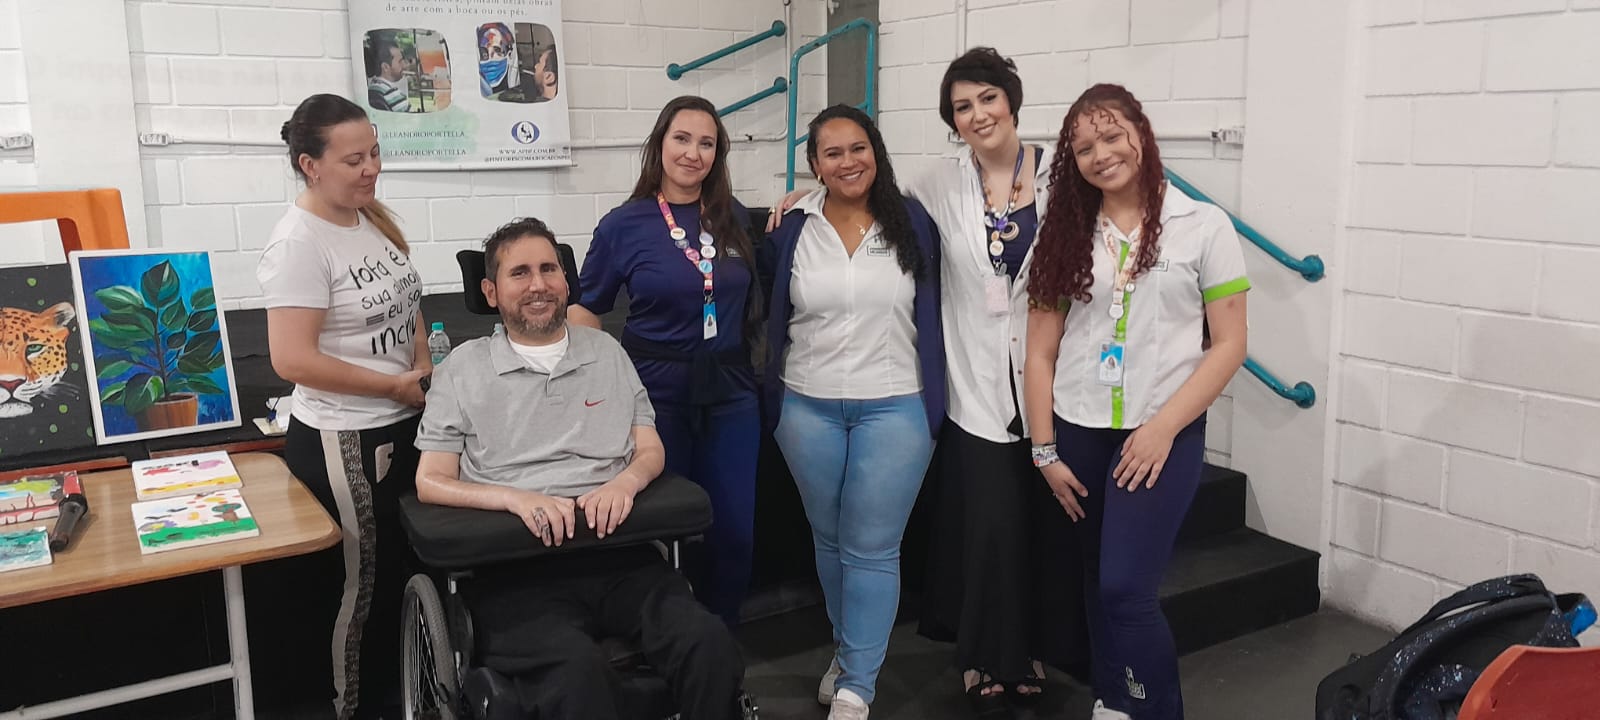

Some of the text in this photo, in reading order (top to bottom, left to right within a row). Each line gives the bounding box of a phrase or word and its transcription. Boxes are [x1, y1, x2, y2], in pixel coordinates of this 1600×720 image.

[385, 2, 396, 12] de
[400, 5, 419, 13] arte
[423, 6, 443, 14] com
[456, 4, 478, 15] boca
[510, 7, 528, 18] pés.
[361, 289, 392, 310] sua
[388, 289, 420, 319] eu so
